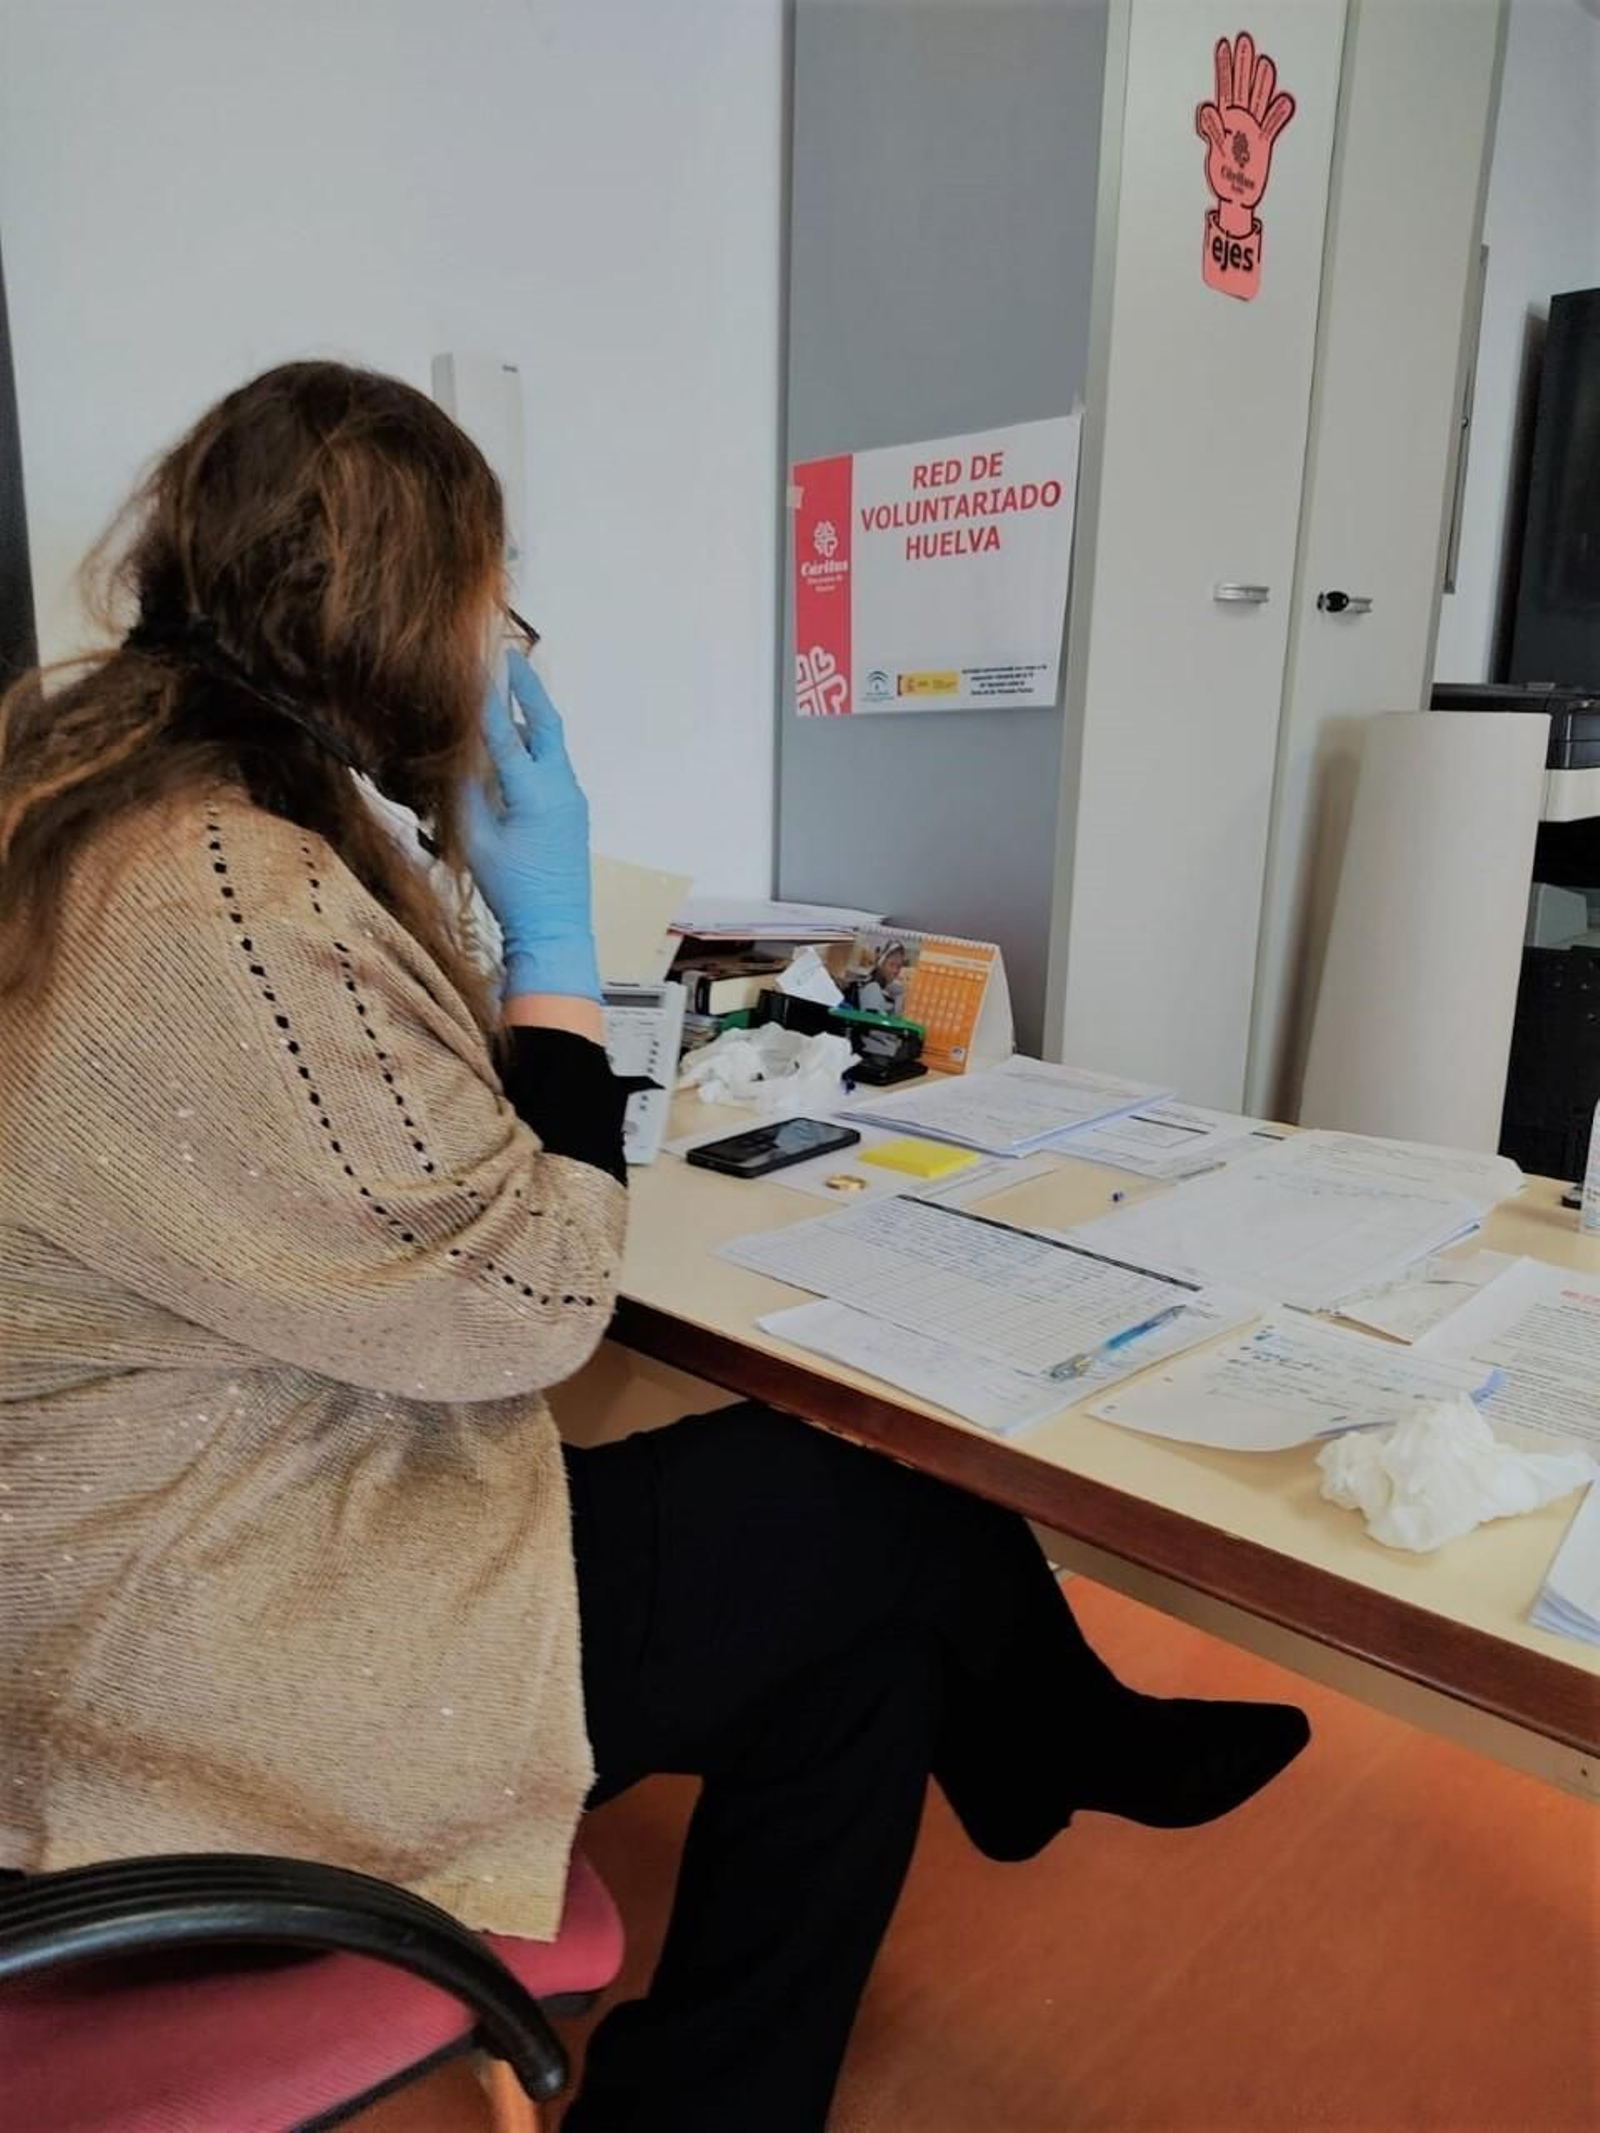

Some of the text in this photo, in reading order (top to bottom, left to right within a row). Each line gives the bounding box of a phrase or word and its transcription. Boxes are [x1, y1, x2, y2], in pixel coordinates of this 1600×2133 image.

[1212, 230, 1254, 271] ejes
[912, 452, 1003, 490] RED DE
[861, 480, 1062, 532] VOLUNTARIADO
[905, 525, 1001, 560] HUELVA
